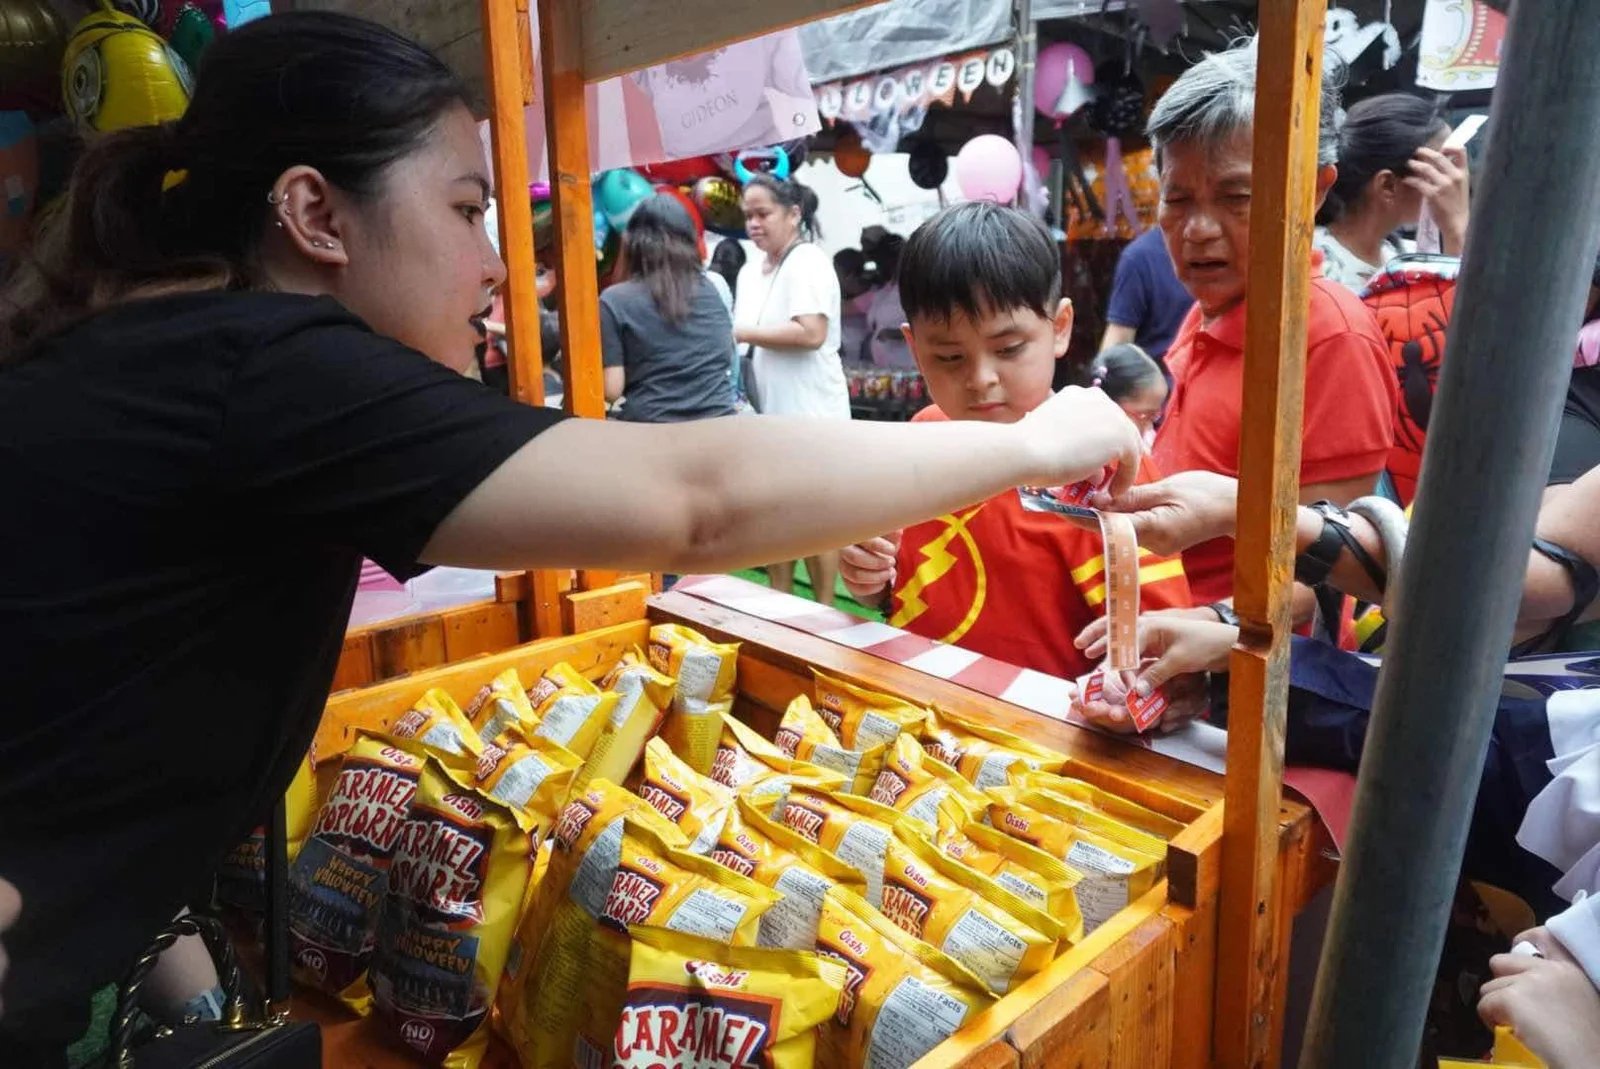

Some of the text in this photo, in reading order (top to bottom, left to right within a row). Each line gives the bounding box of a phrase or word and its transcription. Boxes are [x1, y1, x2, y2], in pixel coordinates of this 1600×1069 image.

[824, 52, 1011, 111] LLOWEEN
[681, 90, 737, 129] GIDEON
[379, 746, 415, 767] Ois
[333, 769, 418, 818] ARAMEL
[641, 786, 686, 823] RAMEL
[784, 804, 823, 838] RAMEL
[1005, 812, 1029, 831] Oishi
[398, 820, 483, 882] ARAMEL
[736, 833, 760, 854] Oishi
[388, 857, 480, 909] OPCORN
[612, 870, 660, 909] RAMEL
[602, 894, 649, 924] PCORN
[882, 884, 929, 926] RAMEL
[839, 929, 868, 956] Oishi
[969, 909, 1022, 950] Nutrition Facts
[301, 953, 323, 971] NO
[937, 994, 962, 1014] Facts
[405, 1024, 432, 1040] NO
[614, 1003, 766, 1069] CARAMEL
